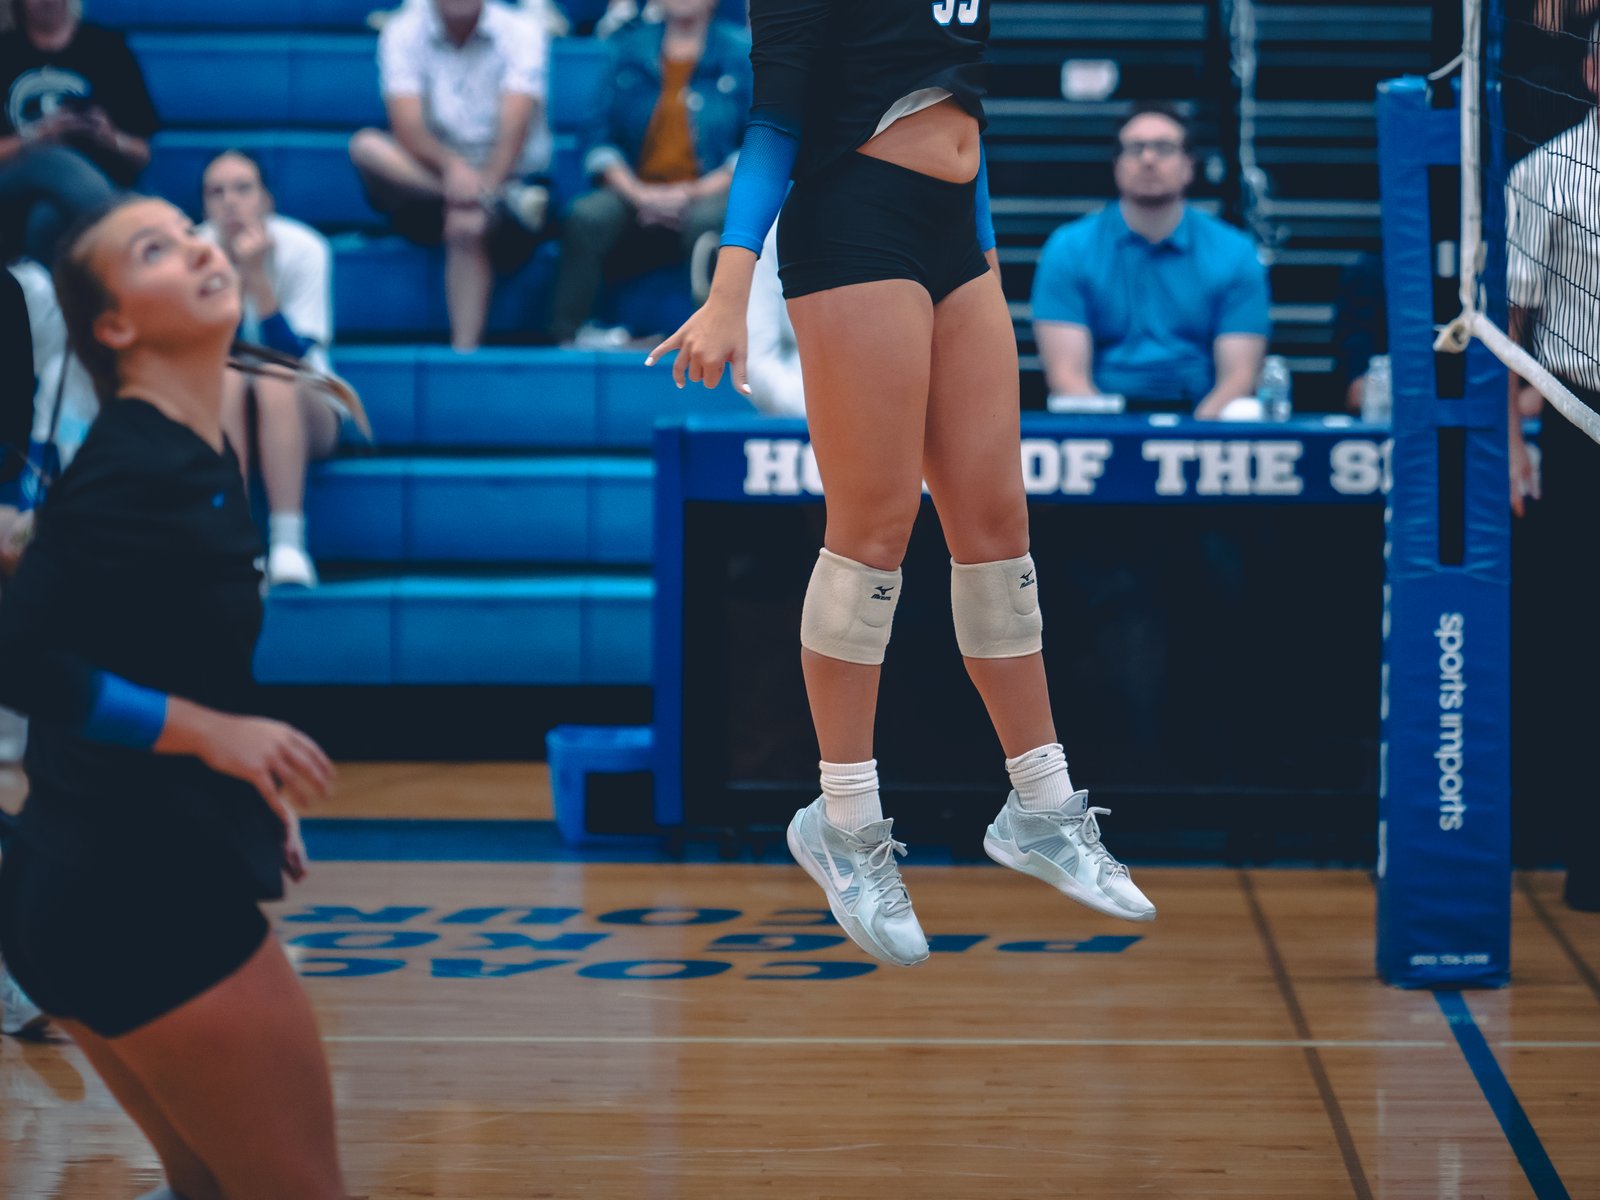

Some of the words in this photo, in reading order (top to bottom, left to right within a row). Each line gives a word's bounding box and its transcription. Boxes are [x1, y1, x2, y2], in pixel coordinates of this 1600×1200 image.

[1020, 438, 1113, 495] OF
[1141, 439, 1304, 495] THE
[1433, 612, 1468, 709] sports
[1433, 712, 1468, 831] imports
[280, 905, 842, 926] COUR
[299, 957, 879, 980] COAC
